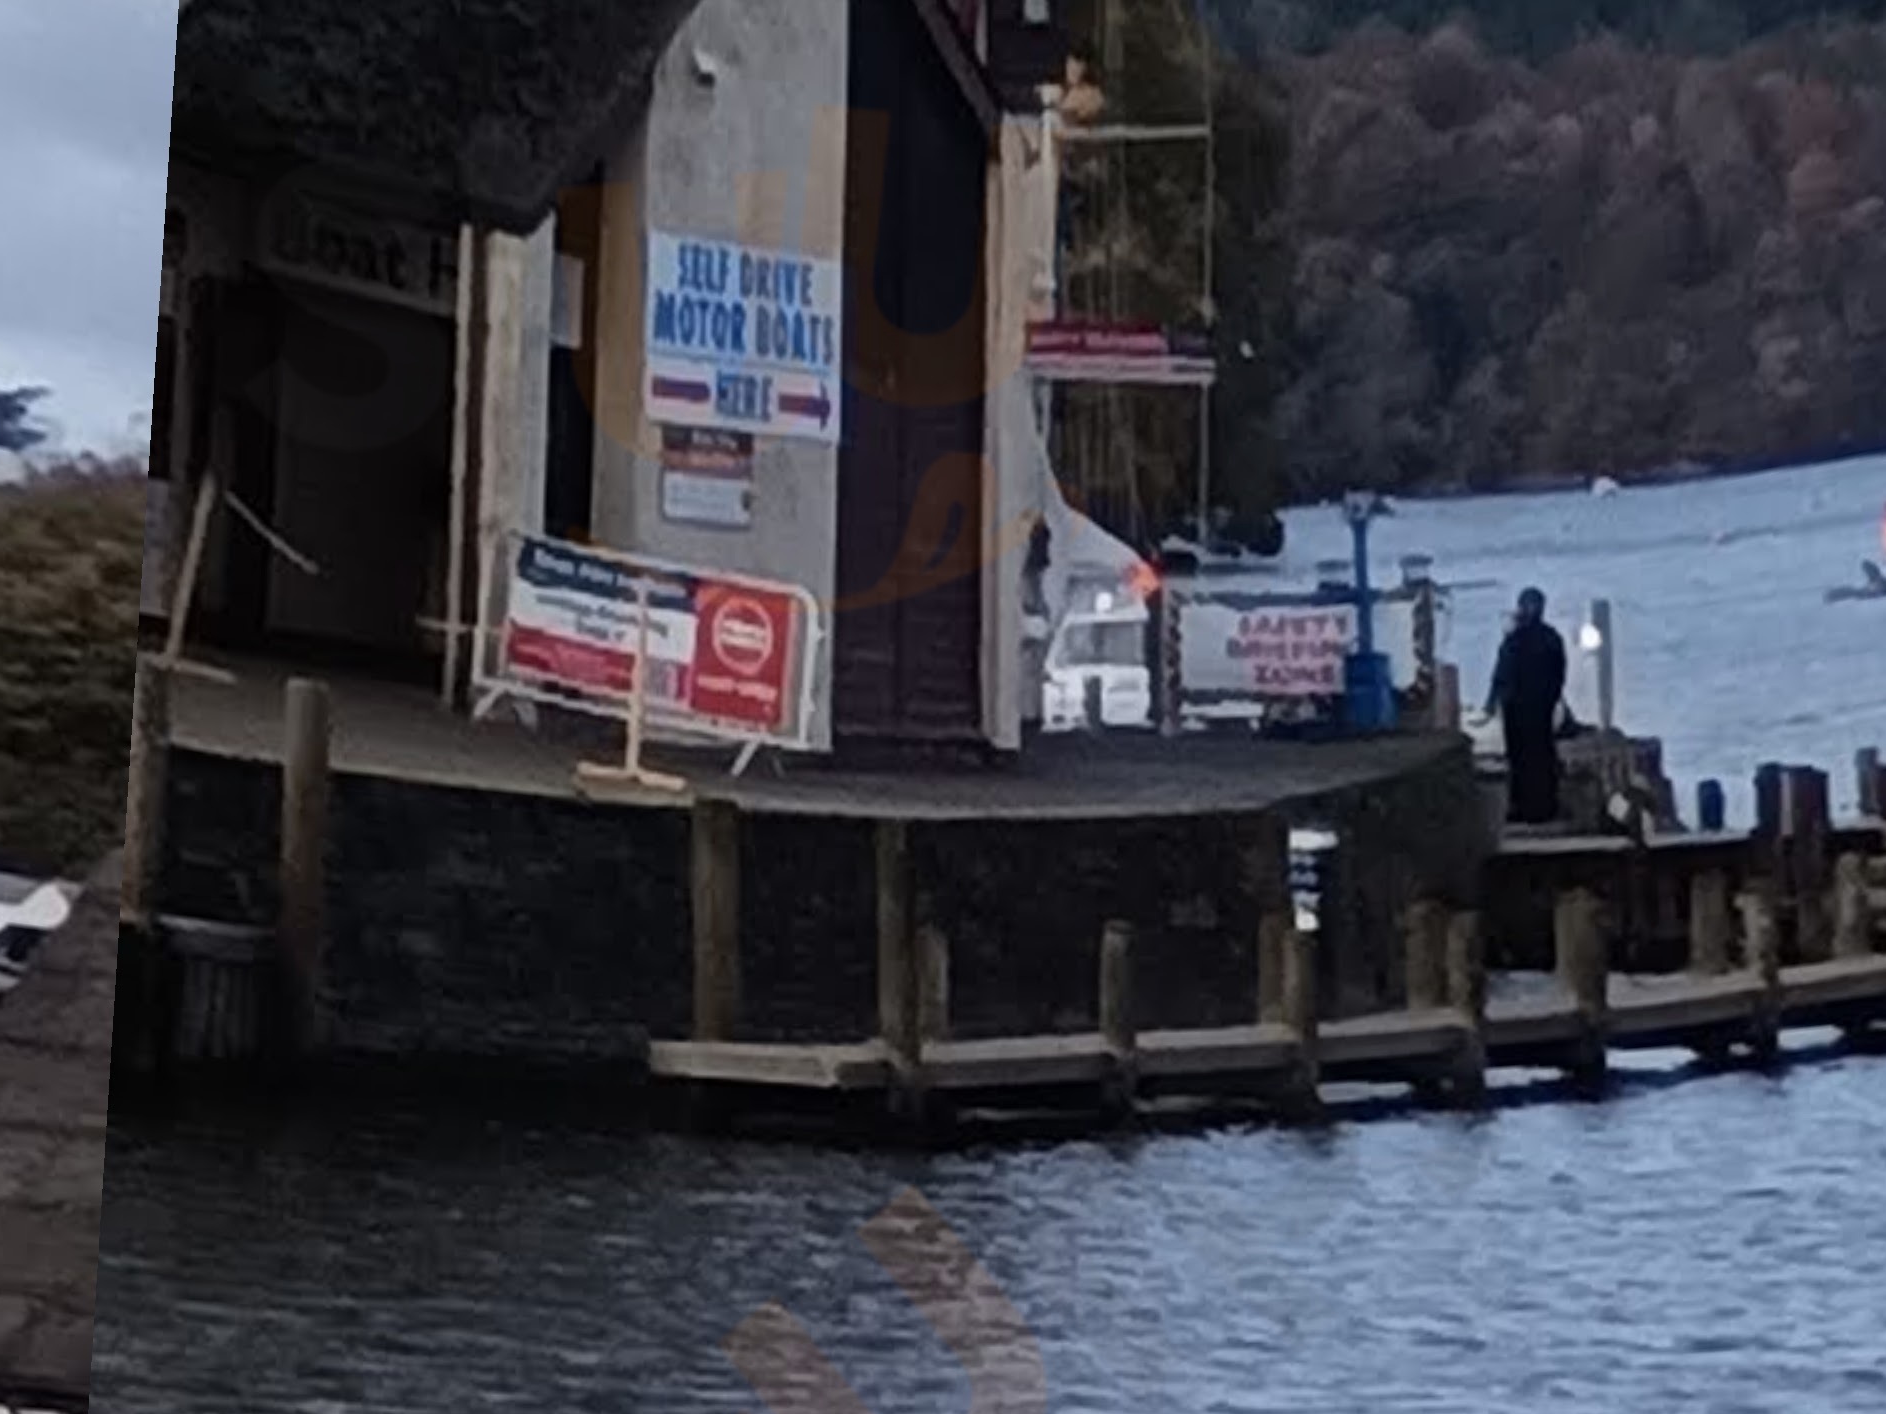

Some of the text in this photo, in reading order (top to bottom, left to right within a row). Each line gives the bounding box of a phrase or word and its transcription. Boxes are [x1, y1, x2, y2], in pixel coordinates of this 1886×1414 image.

[678, 244, 813, 306] SELF DRIVE
[653, 289, 835, 366] MOTOR BOATS
[717, 371, 774, 423] HERE
